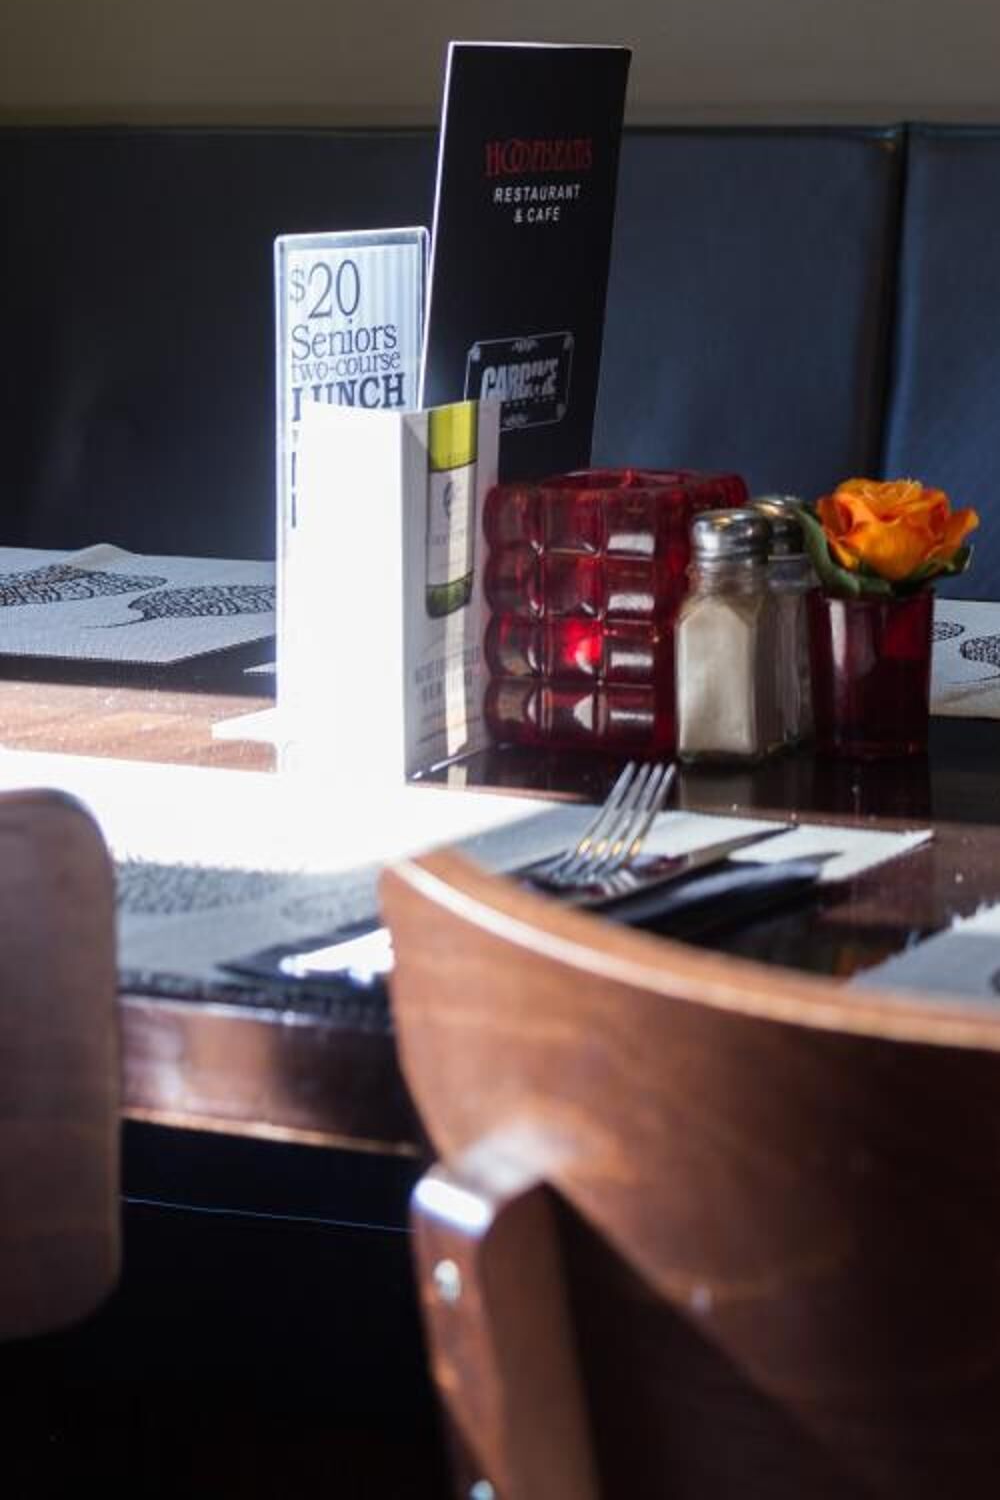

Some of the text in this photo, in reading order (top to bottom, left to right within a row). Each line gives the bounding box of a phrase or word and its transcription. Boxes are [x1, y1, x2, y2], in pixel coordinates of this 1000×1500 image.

[493, 184, 581, 203] RESTAURANT
[513, 206, 561, 223] & CAFE
[290, 259, 361, 319] $20
[291, 318, 398, 361] Seniors
[291, 350, 401, 383] two-course
